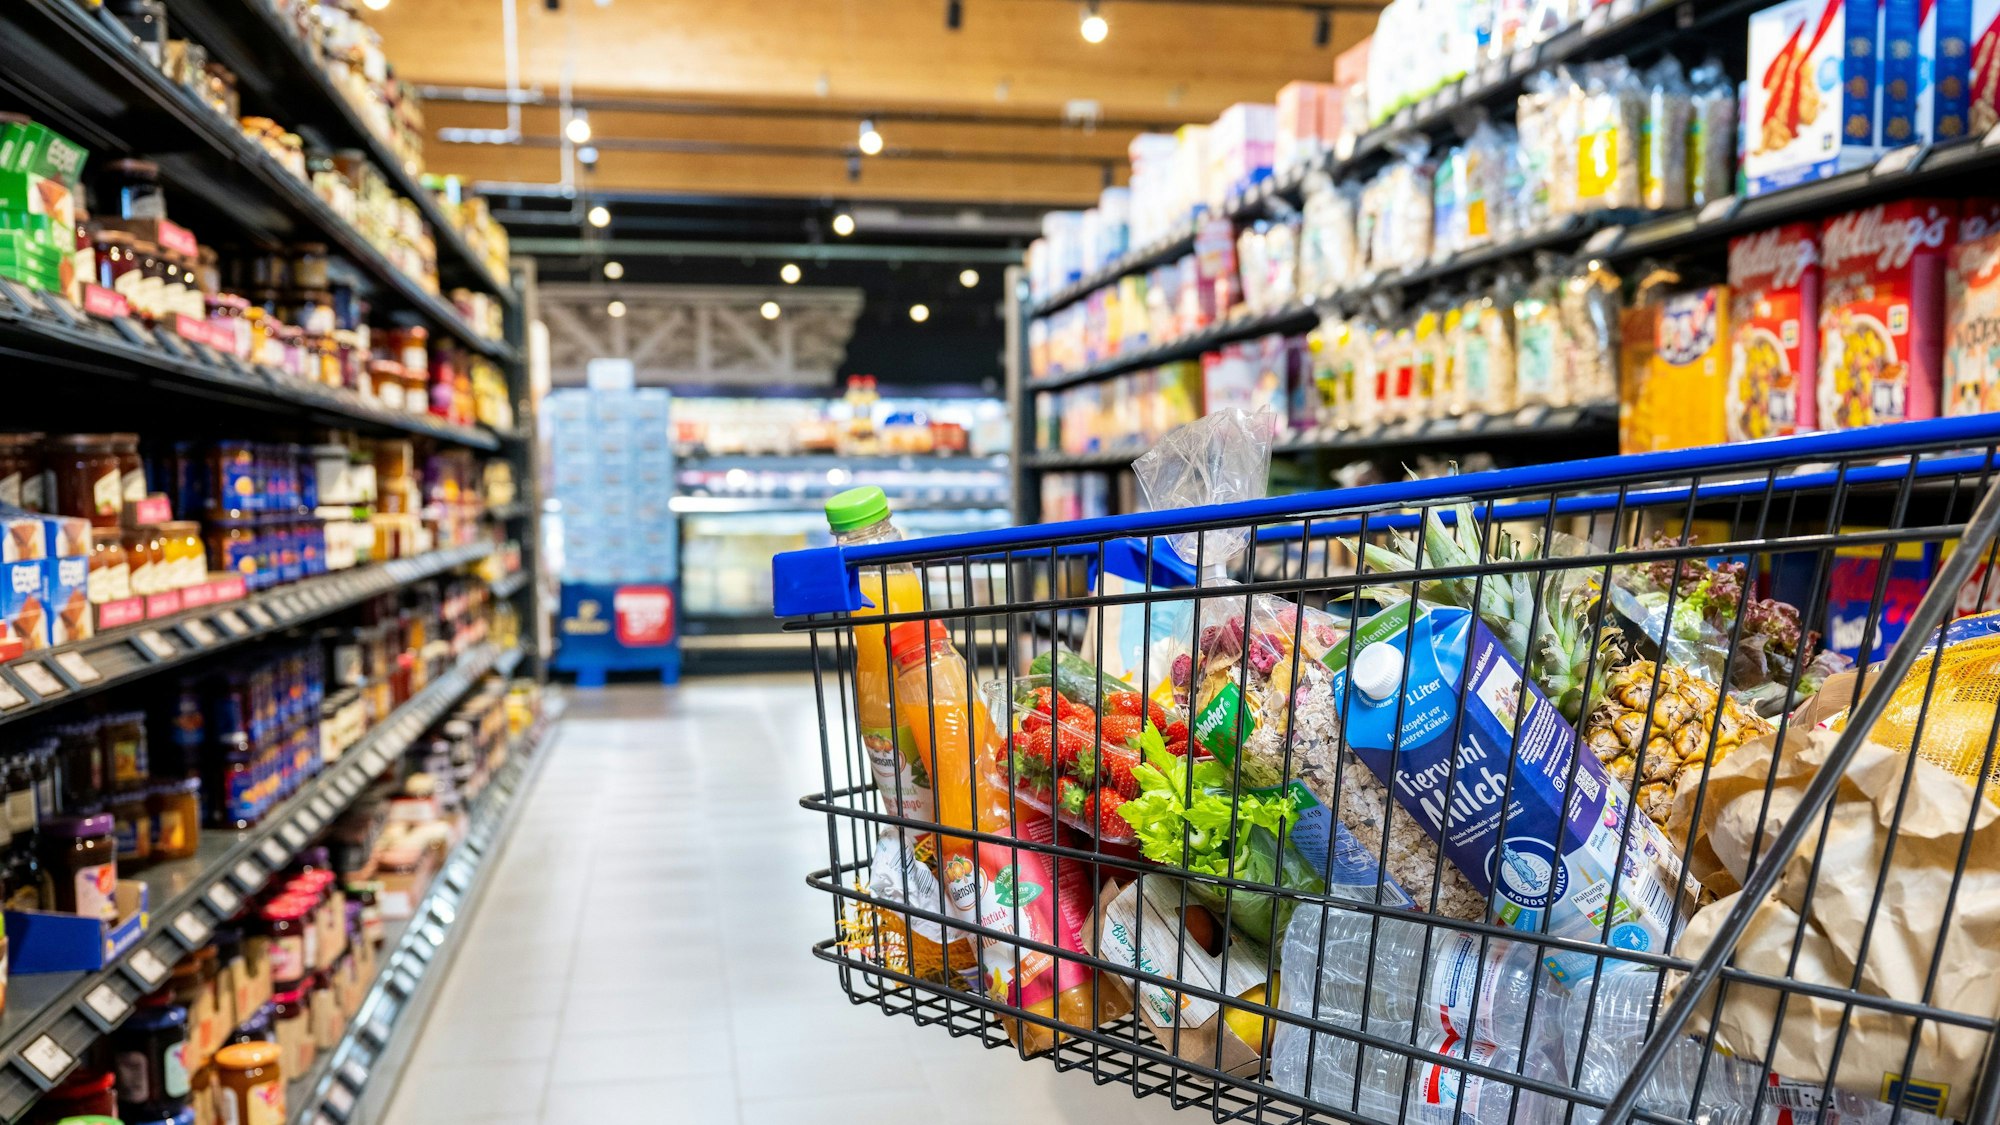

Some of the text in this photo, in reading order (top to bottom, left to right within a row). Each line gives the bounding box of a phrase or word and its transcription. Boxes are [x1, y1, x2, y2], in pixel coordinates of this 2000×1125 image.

[1822, 205, 1949, 272] Kellogg's
[1604, 612, 1630, 652] EDKA
[1412, 678, 1441, 700] Liter
[1428, 706, 1441, 717] vor
[1420, 767, 1515, 831] Milch
[1554, 866, 1566, 895] MILCH
[1573, 882, 1607, 904] Haltungs-
[1586, 892, 1605, 905] form
